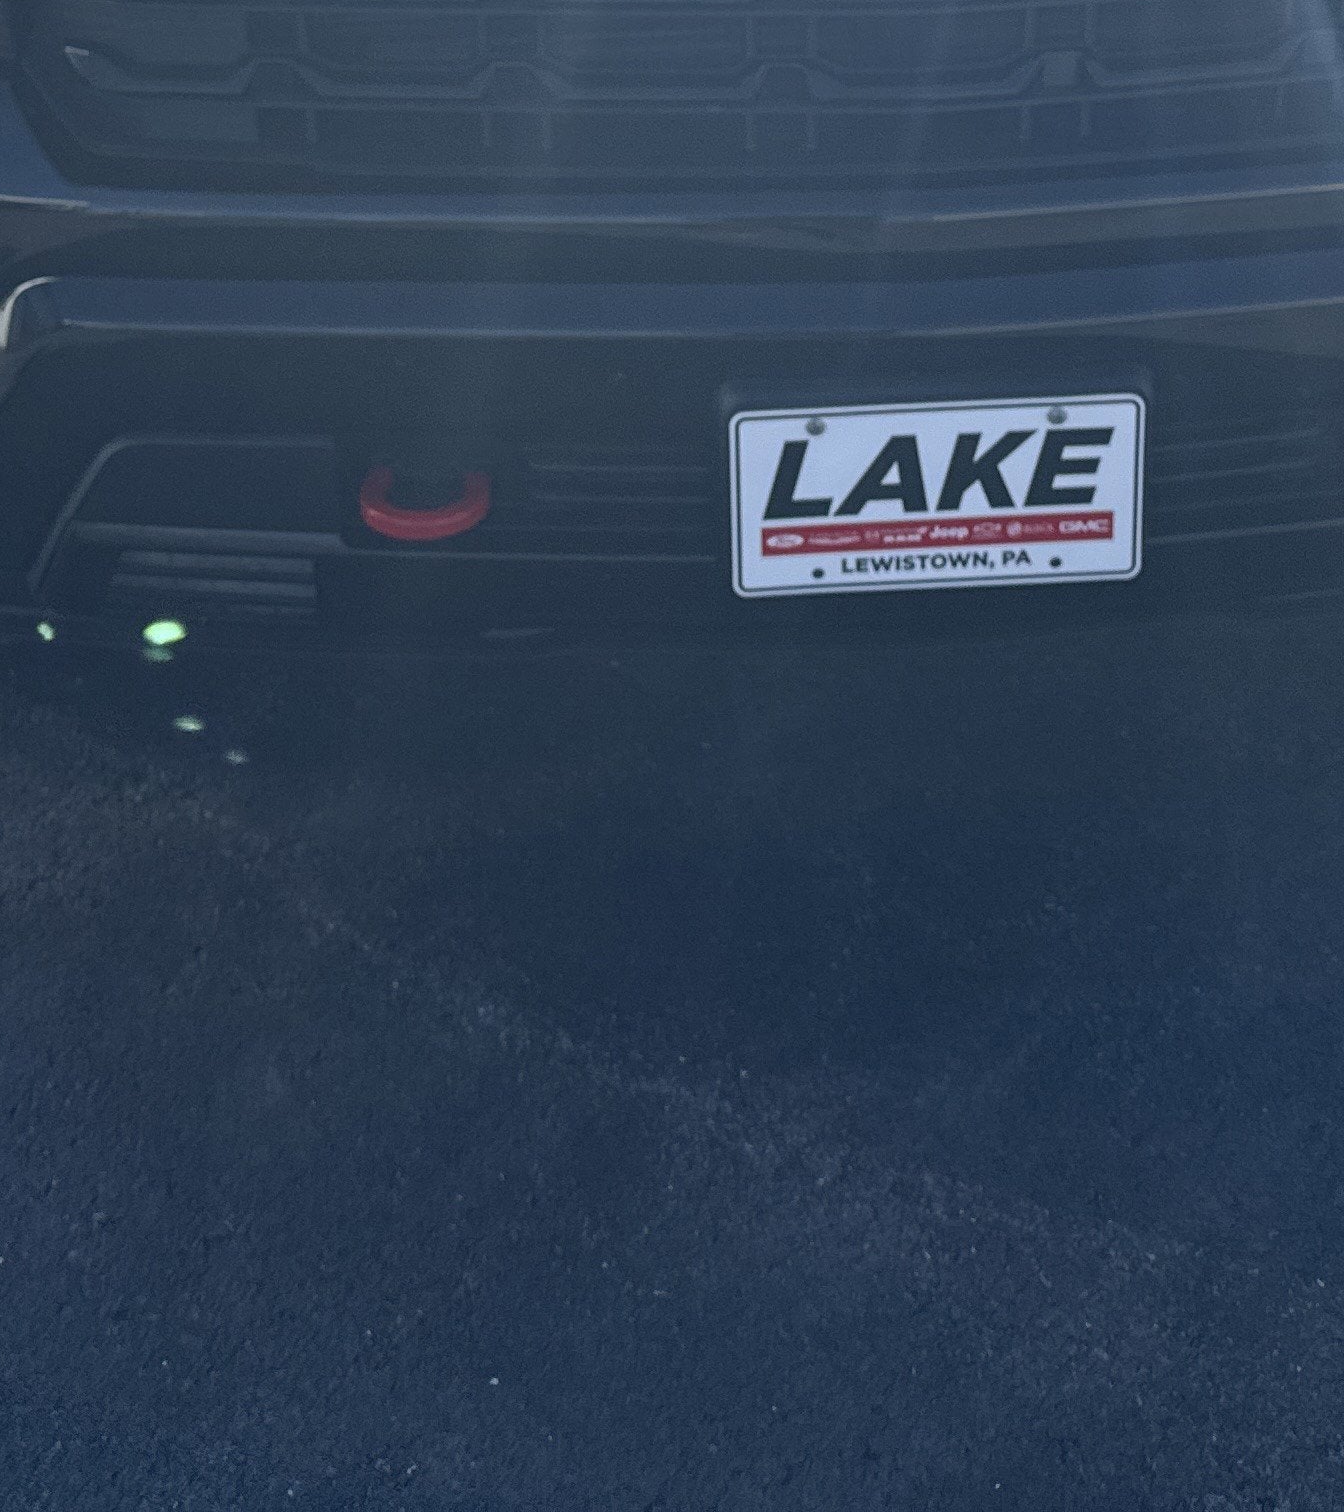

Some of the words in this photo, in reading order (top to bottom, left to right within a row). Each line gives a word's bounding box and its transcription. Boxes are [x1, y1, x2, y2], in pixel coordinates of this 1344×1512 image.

[763, 426, 1115, 520] LAKE
[841, 551, 994, 574] LEWISTOWN,
[1002, 549, 1031, 567] PA
